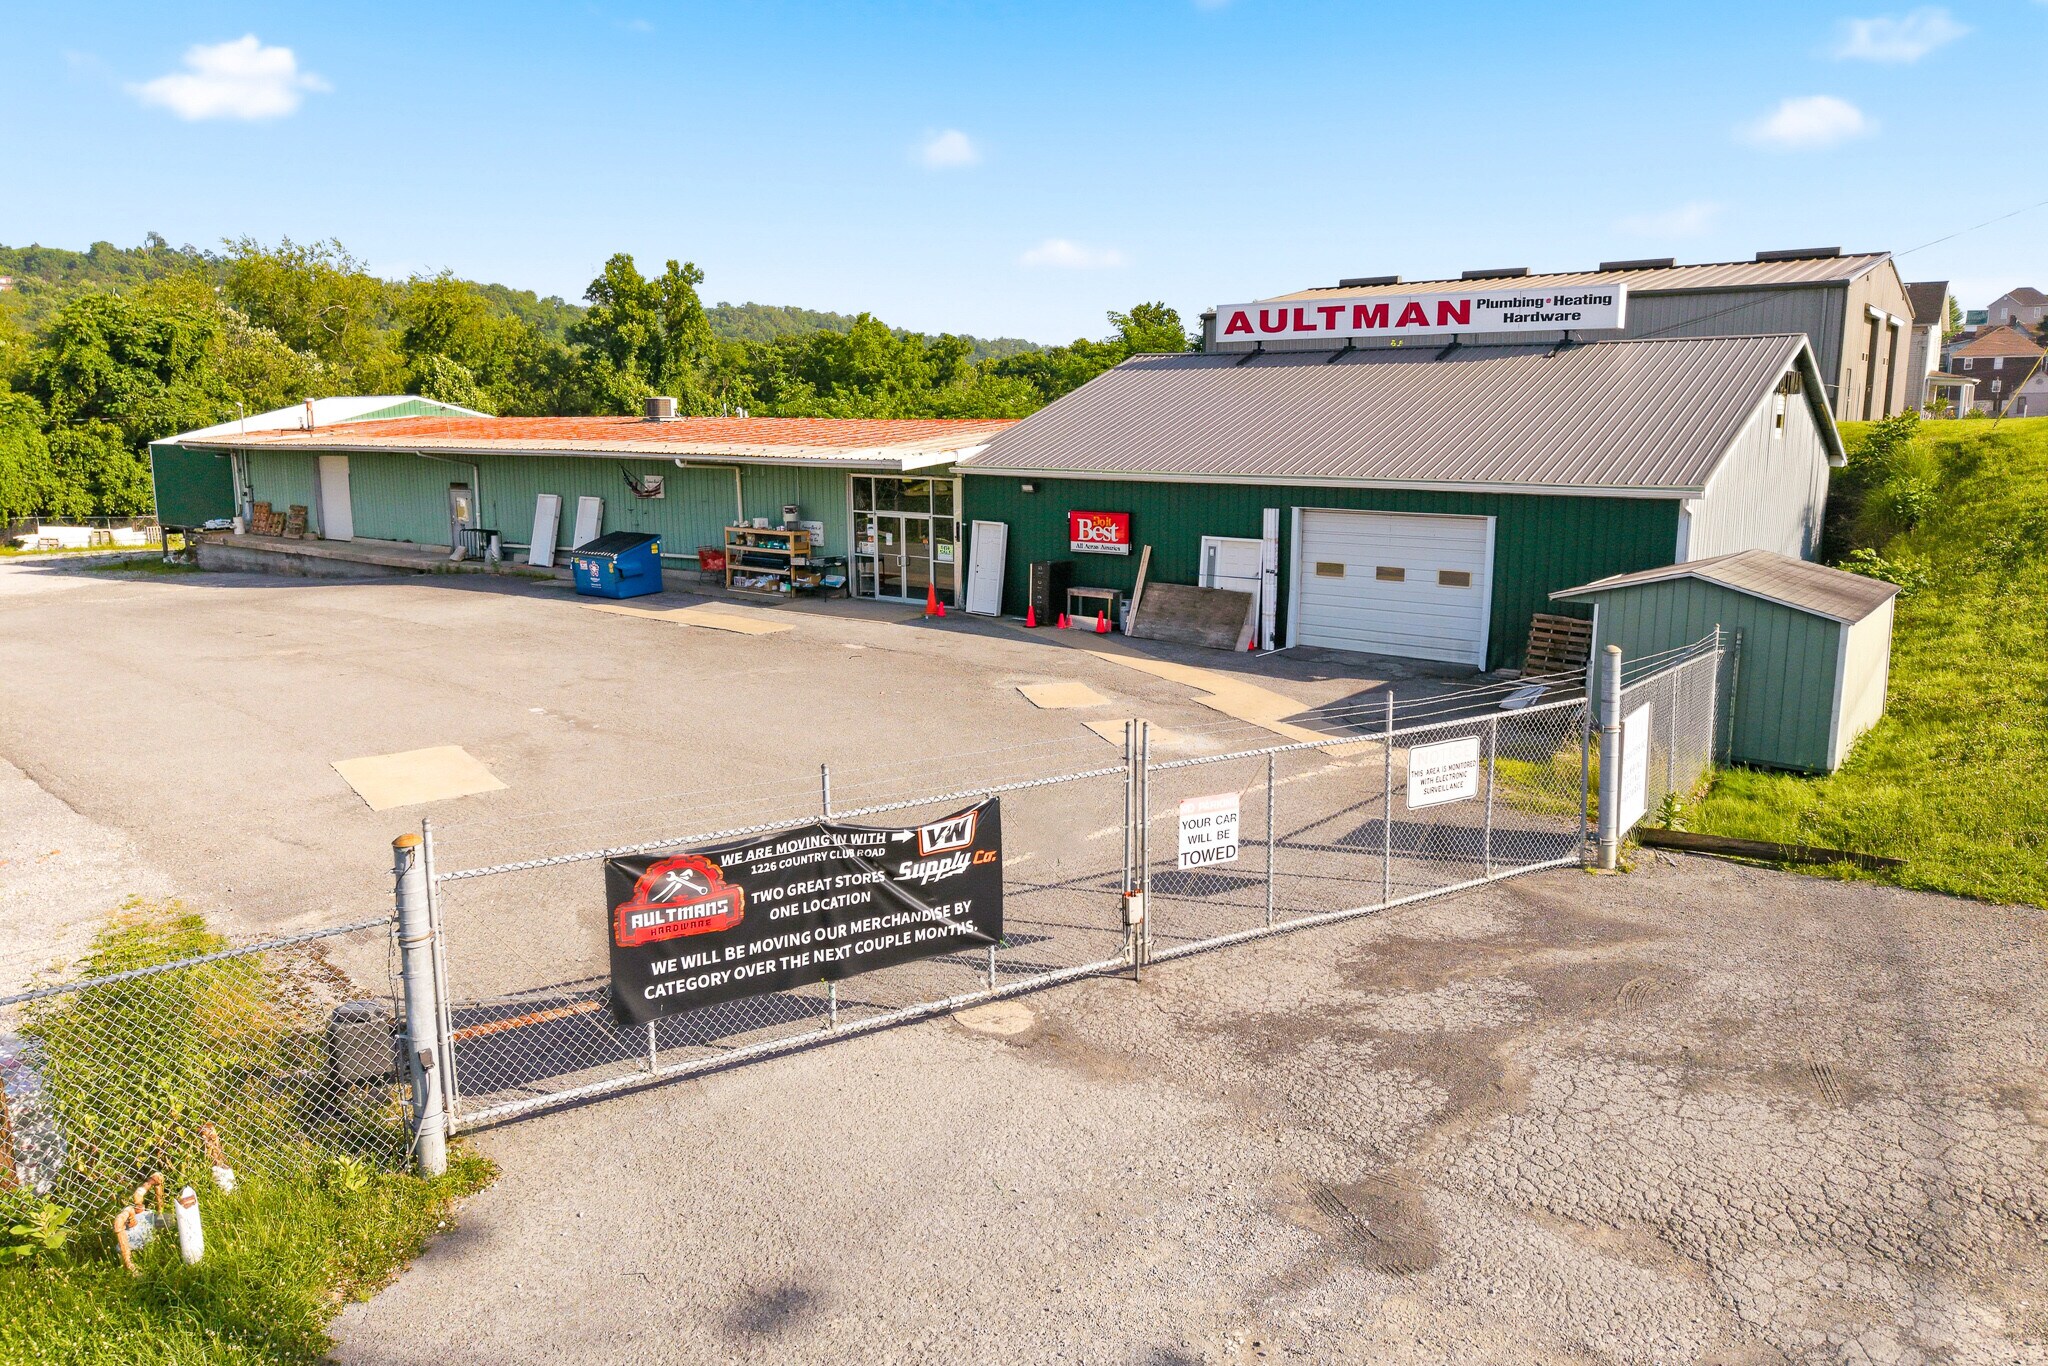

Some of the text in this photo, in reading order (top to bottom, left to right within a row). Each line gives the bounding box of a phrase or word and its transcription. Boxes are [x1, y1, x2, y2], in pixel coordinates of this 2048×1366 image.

[1476, 294, 1612, 309] Plumbing Heating
[1224, 299, 1471, 335] AULTMAN
[1503, 311, 1582, 323] Hardware
[1077, 518, 1119, 542] Best
[1093, 515, 1105, 526] Do
[1416, 744, 1472, 766] NOTICE
[1411, 760, 1476, 778] THIS AREA IS MONITORED
[1420, 770, 1468, 785] WITH ELECTRONIC
[1423, 781, 1464, 795] SURVEILLANCE
[1182, 813, 1237, 830] YOUR CAR
[1187, 829, 1230, 845] WILL BE
[720, 832, 887, 867] WE ARE MOVING IN WITH
[1180, 844, 1236, 866] TOWED
[750, 848, 886, 875] 1226 COUNTRY CLUB ROAD
[893, 850, 997, 886] Supply Co.
[751, 870, 886, 904] TWO GREAT STORES
[631, 899, 728, 929] AULTMANS
[769, 891, 871, 920] ONE LOCATION
[650, 918, 712, 936] HARDWARE
[651, 900, 972, 976] WE WILL BE MOVING OUR MERCHANDISE BY
[644, 920, 978, 1000] CATEGORY OVER THE NEXT COUPLE MONTHS.
